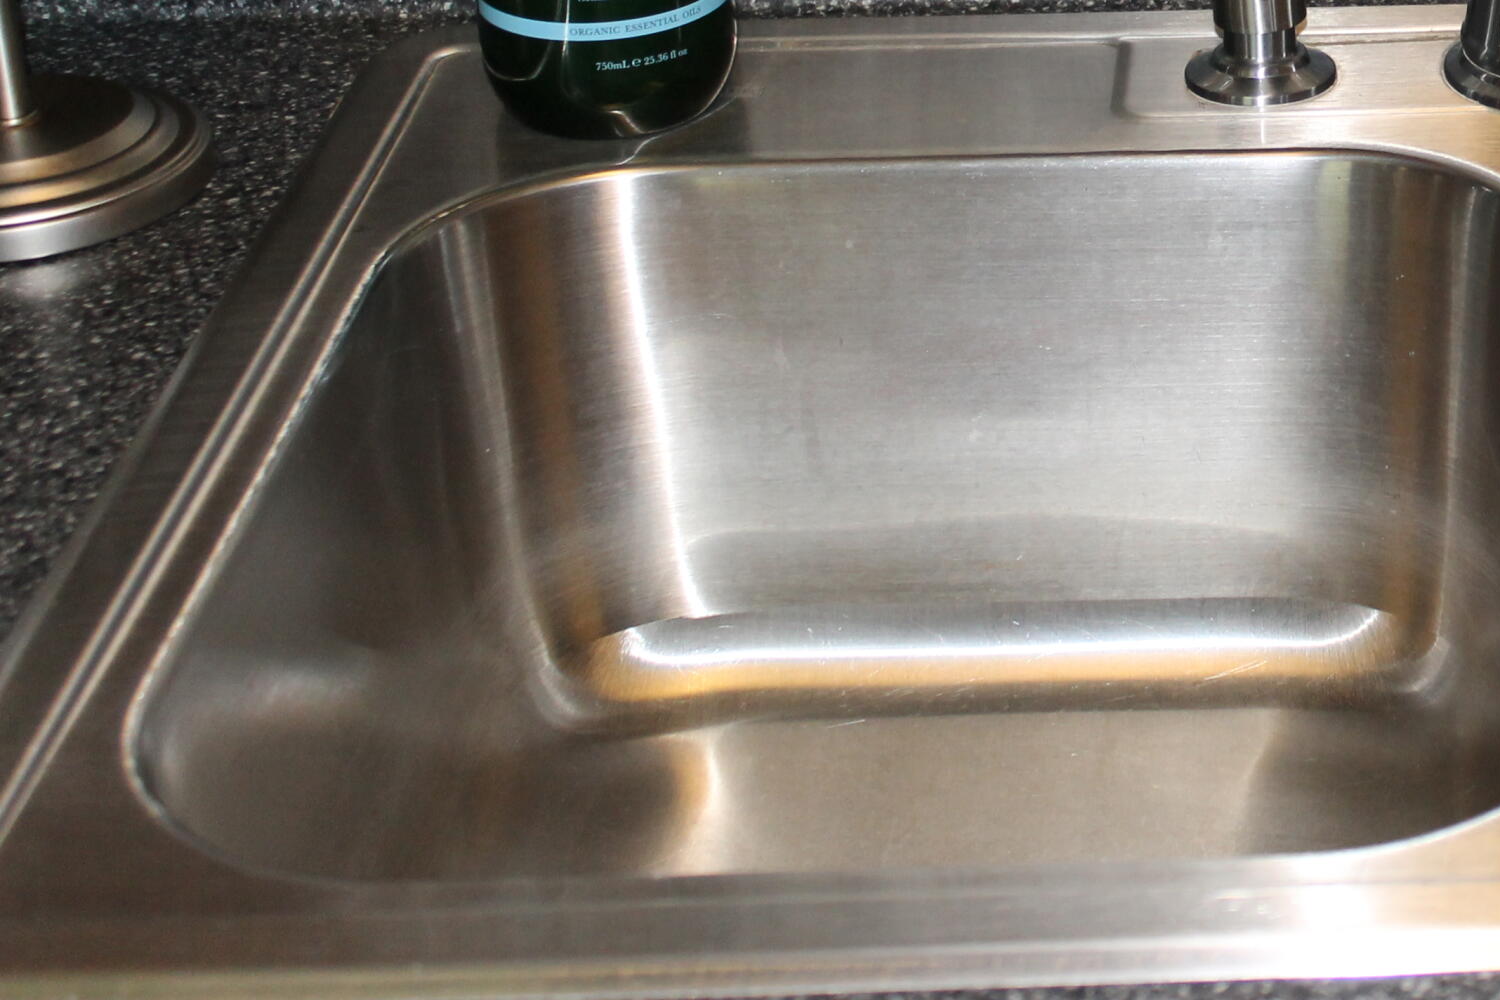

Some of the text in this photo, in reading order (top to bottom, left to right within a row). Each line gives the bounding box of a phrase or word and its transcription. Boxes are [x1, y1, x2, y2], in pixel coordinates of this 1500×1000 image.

[569, 7, 702, 36] ORGANIC ESSENTIAL OILS
[595, 60, 630, 71] 750mL
[643, 52, 668, 66] 25.36
[670, 50, 677, 59] fl
